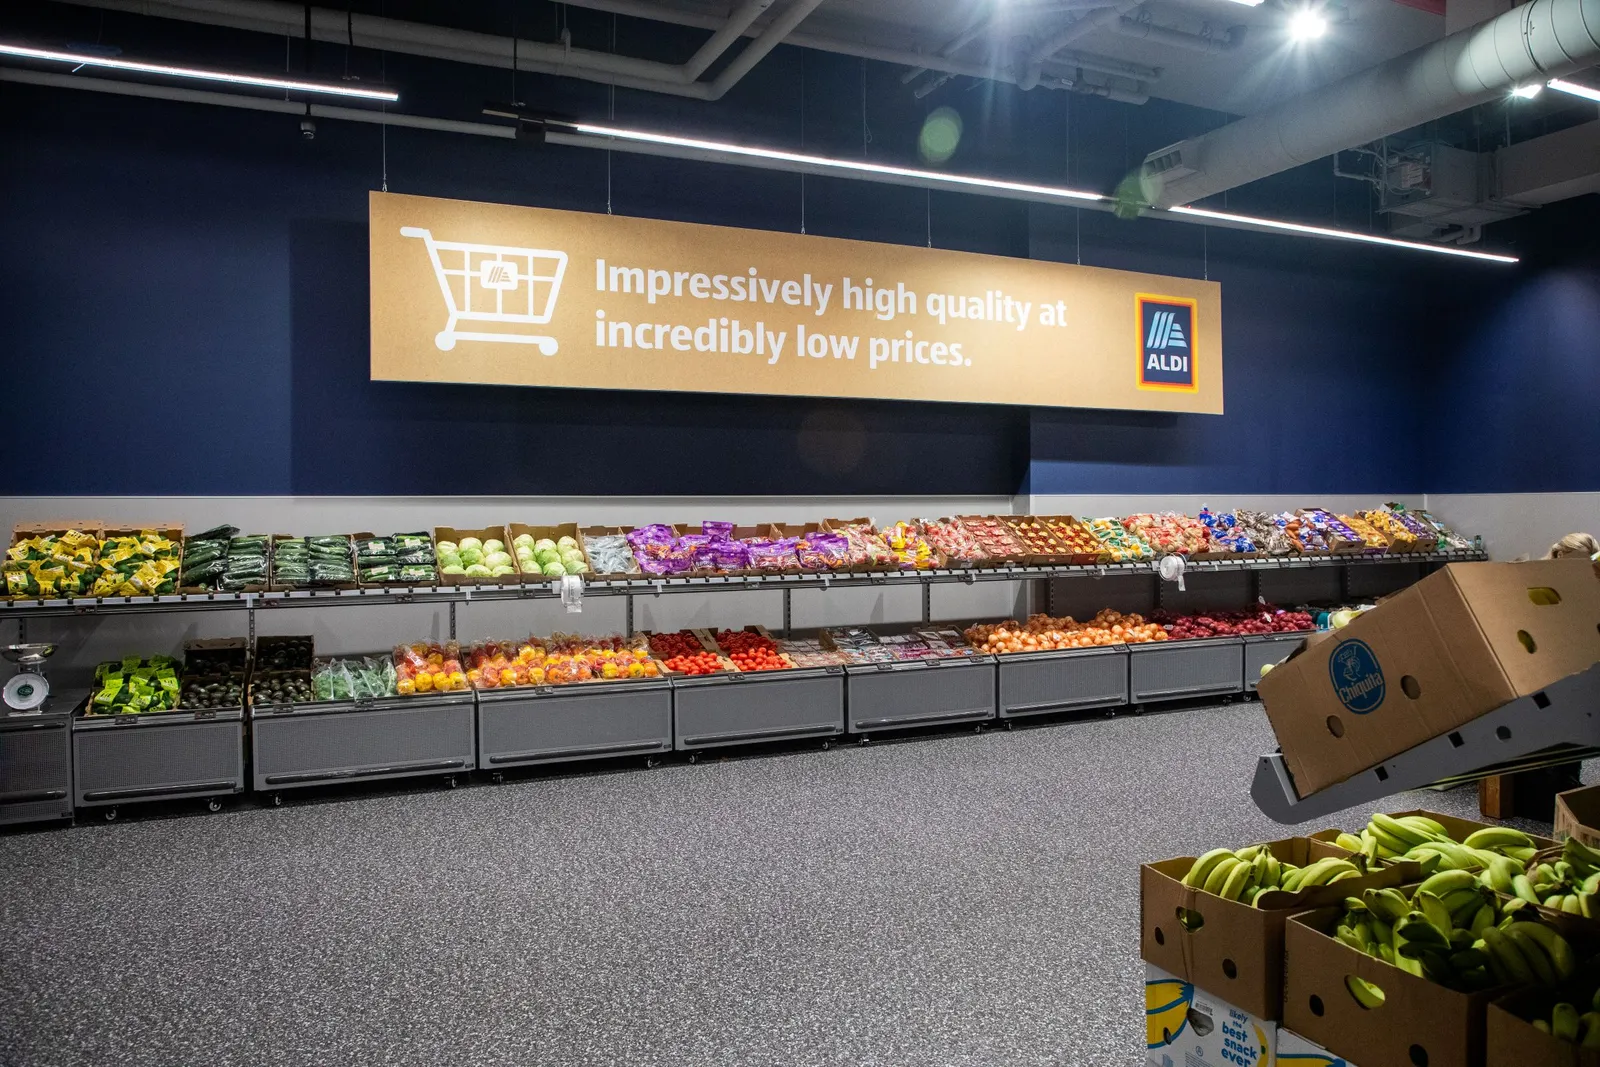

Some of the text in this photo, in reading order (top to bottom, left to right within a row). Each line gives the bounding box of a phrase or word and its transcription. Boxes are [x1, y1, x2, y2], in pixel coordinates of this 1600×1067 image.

[595, 258, 1068, 332] Impressively high quality at
[595, 309, 973, 370] incredibly low prices.
[1147, 353, 1188, 373] ALDI
[1338, 672, 1384, 704] Chiquita
[1229, 1009, 1249, 1024] likely
[1221, 1021, 1248, 1042] best
[1220, 1047, 1252, 1067] ever
[1224, 1037, 1258, 1060] snack
